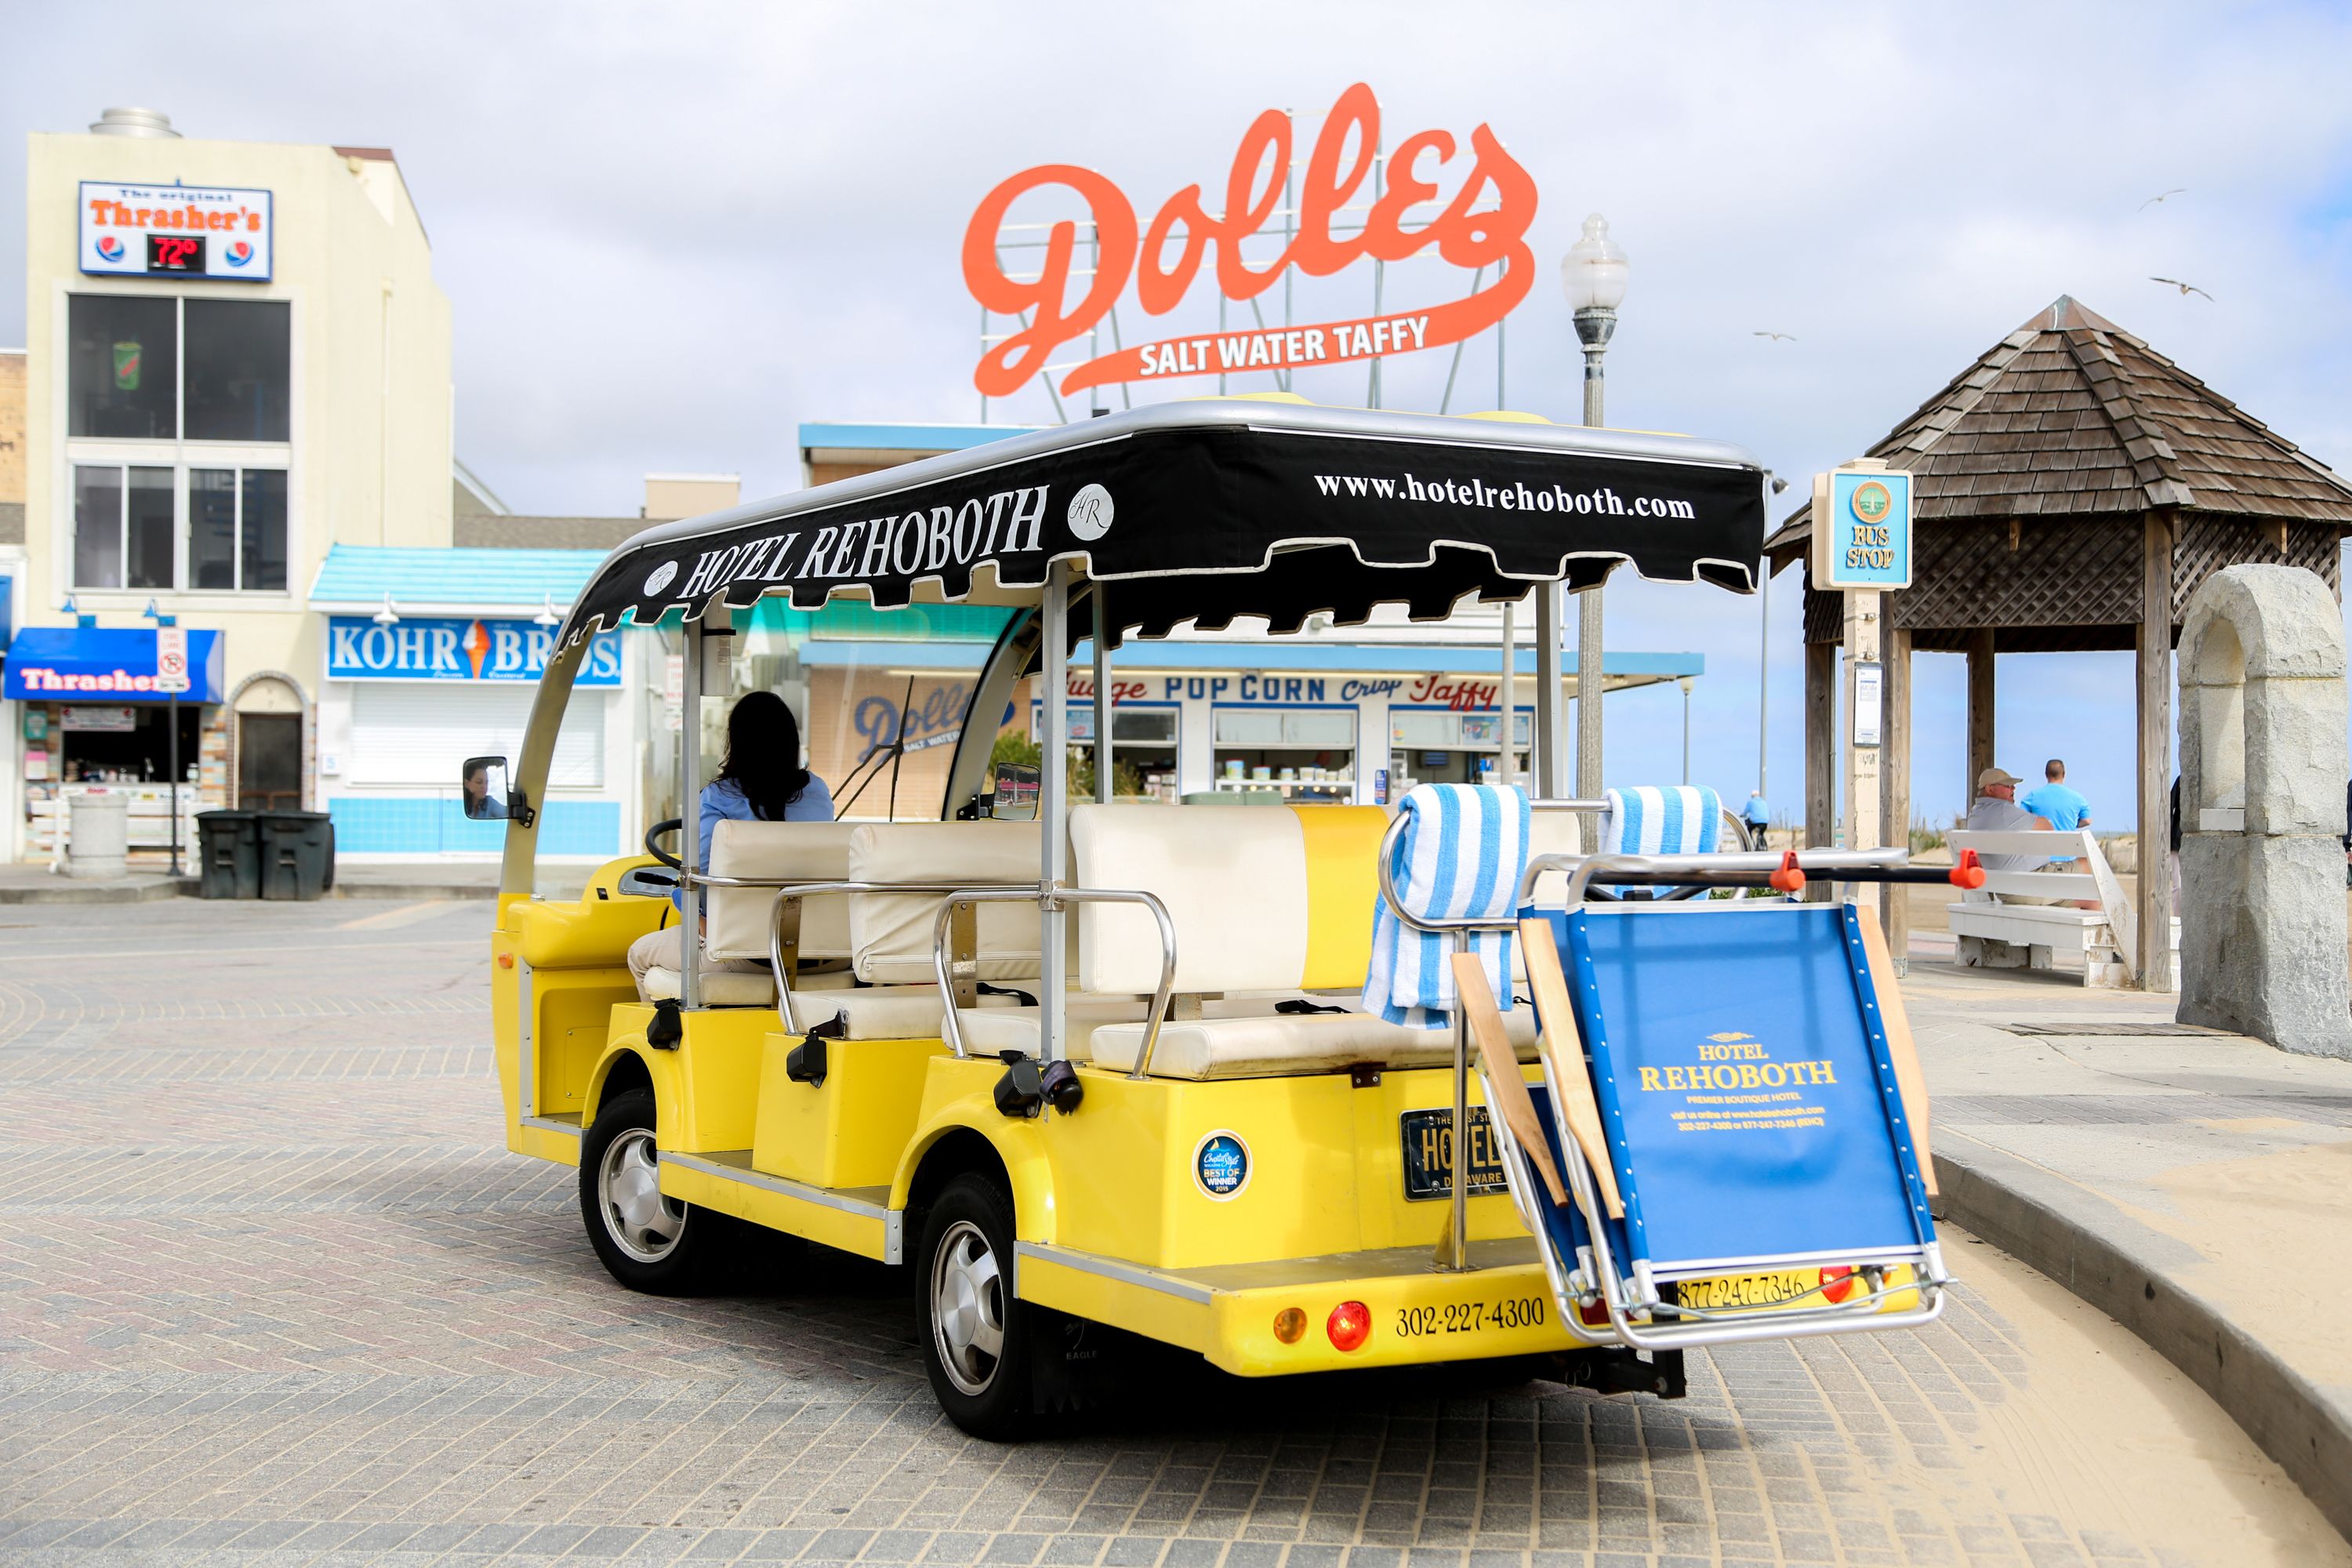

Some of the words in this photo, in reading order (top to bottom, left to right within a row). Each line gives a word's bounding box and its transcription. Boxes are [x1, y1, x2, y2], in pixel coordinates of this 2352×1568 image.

[89, 199, 260, 231] Thrasher's
[1139, 339, 1211, 376] SALT
[1217, 328, 1327, 369] WATER
[1332, 314, 1429, 358] TAFFY
[1314, 473, 1695, 519] www.hotelrehoboth.com
[677, 532, 800, 599] HOTEL
[800, 485, 1051, 579] REHOBOTH
[1852, 524, 1890, 546] BUS
[1846, 548, 1895, 569] STOP
[331, 625, 460, 671] KOHR
[1066, 671, 1147, 707] uge
[1165, 677, 1229, 699] POP
[1240, 675, 1325, 701] CORN
[1410, 674, 1497, 712] Taffy
[1697, 1044, 1769, 1061] HOTEL
[1638, 1060, 1838, 1091] REHOBOTH
[1686, 1094, 1724, 1104] PREMIER
[1725, 1094, 1770, 1104] BOUTIQUE
[1772, 1092, 1802, 1102] HOTEL
[1437, 1116, 1452, 1125] THE
[1421, 1124, 1502, 1171] HOEL
[1203, 1169, 1225, 1178] BEST
[1227, 1167, 1240, 1177] OF
[1207, 1177, 1237, 1186] WINNER
[1444, 1172, 1503, 1187] DAWARE
[1677, 1272, 1806, 1308] 877-247-7346
[1396, 1297, 1544, 1338] 302-227-4300
